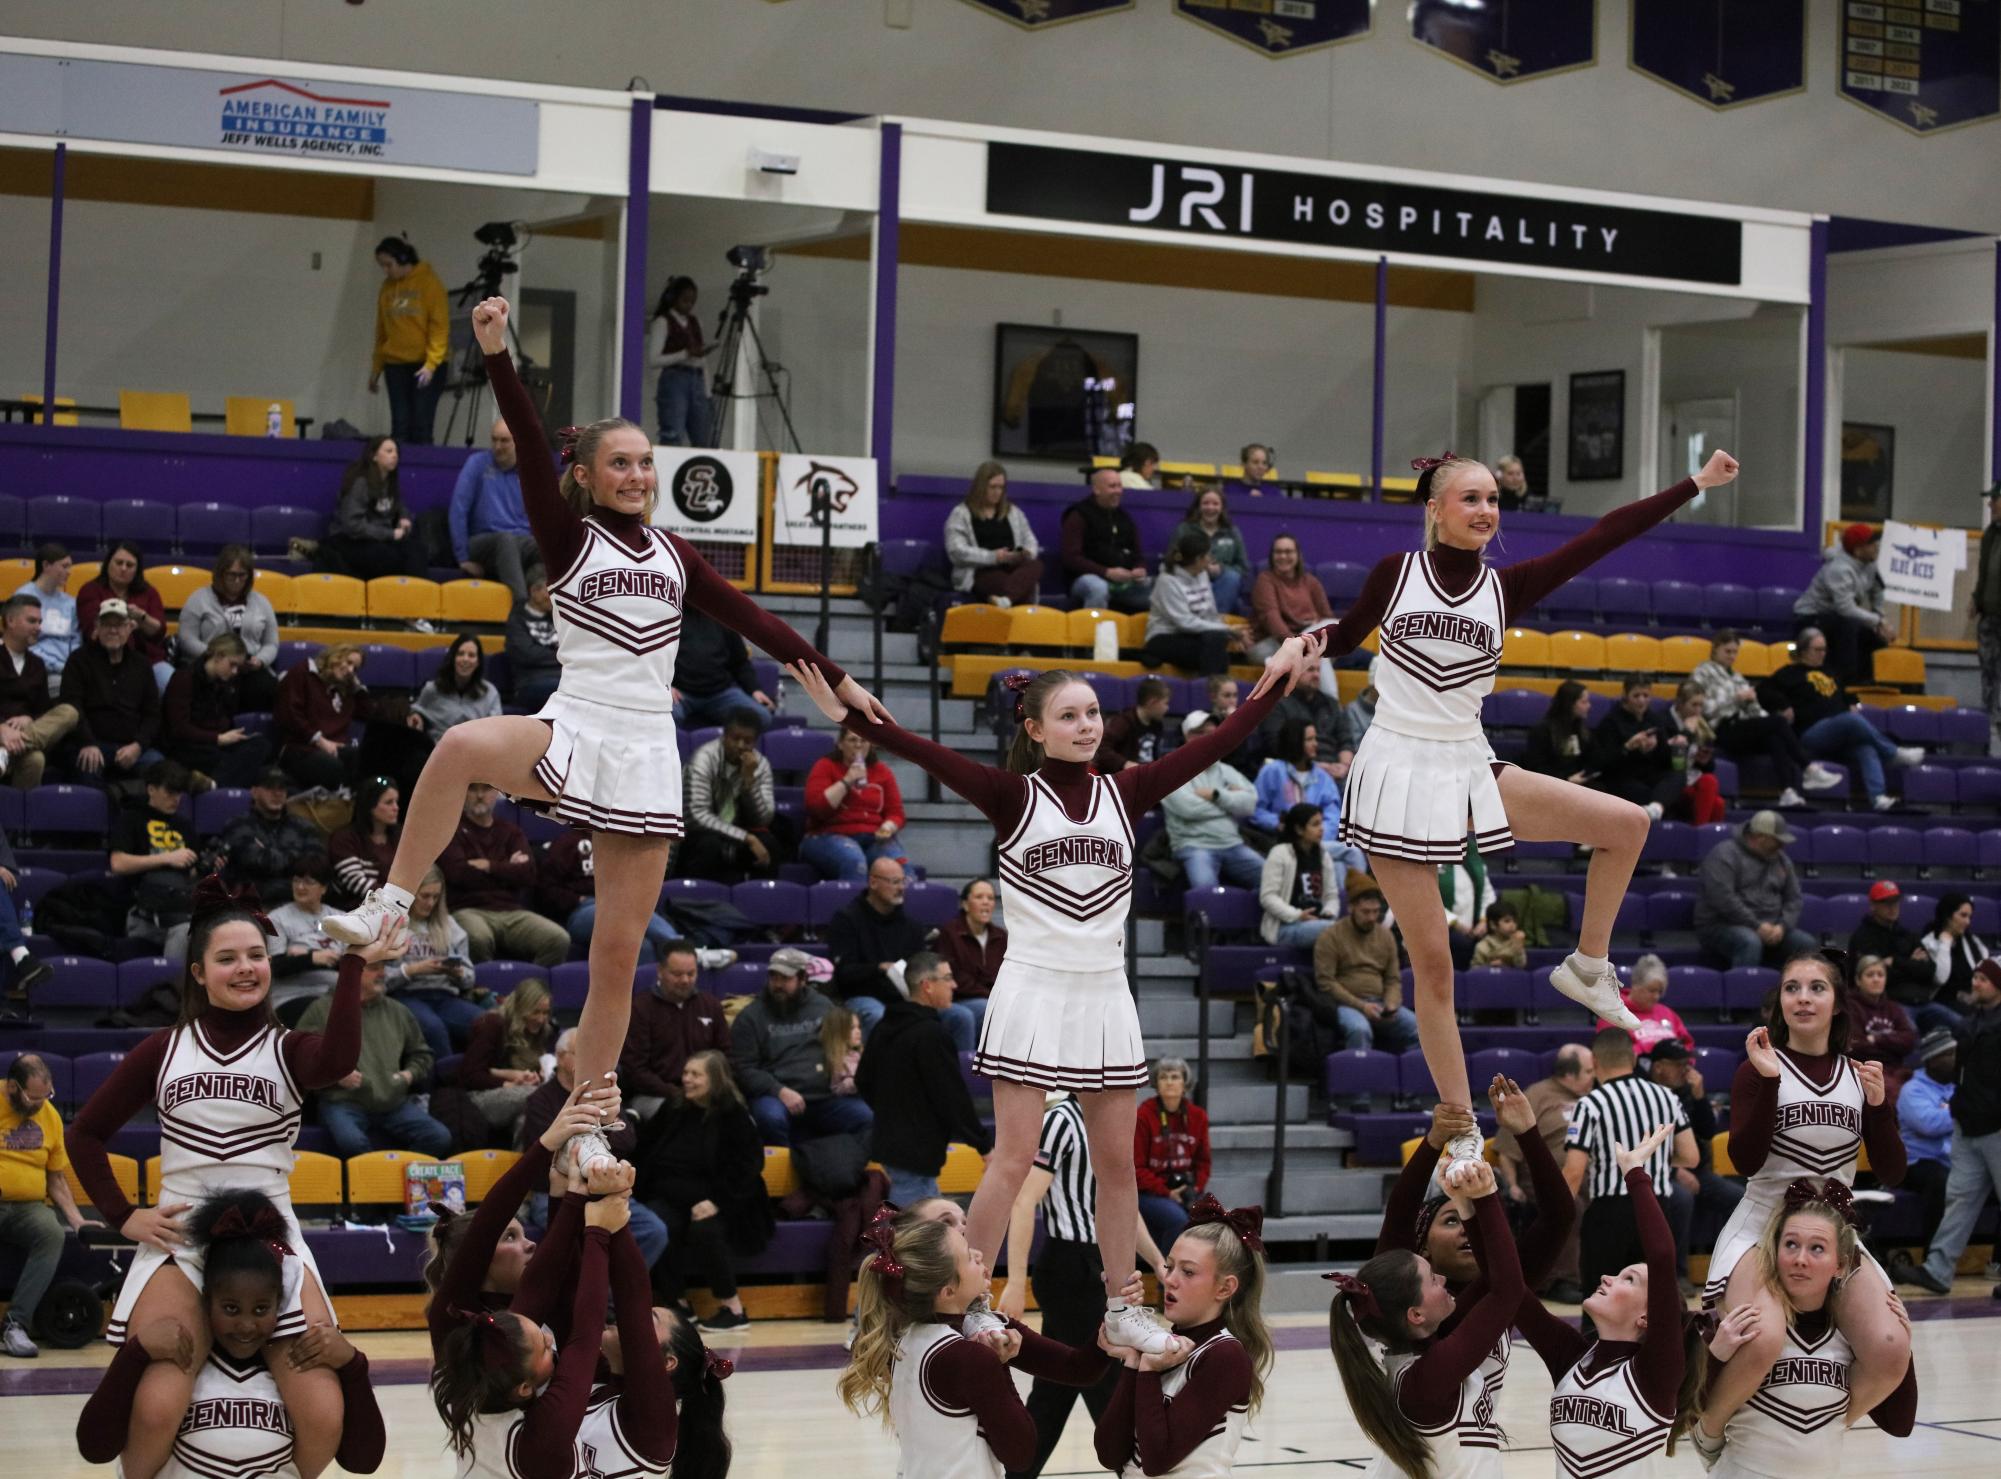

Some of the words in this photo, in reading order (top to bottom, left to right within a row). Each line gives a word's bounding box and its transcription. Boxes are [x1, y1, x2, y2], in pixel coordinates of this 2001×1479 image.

[223, 99, 316, 119] AMERICAN
[325, 108, 386, 126] FAMILY
[235, 118, 372, 140] INSURANCE
[221, 132, 254, 145] JEFF
[254, 135, 297, 149] WELLS
[300, 139, 356, 155] AGENCY,
[358, 144, 385, 157] INC.
[1129, 164, 1253, 232] JRI
[1294, 195, 1618, 253] HOSPITALITY
[1388, 611, 1500, 660] CENTRAL
[1023, 835, 1131, 877] CENTRAL
[165, 1072, 284, 1118] CENTRAL
[1550, 1395, 1637, 1438] ENTRAL
